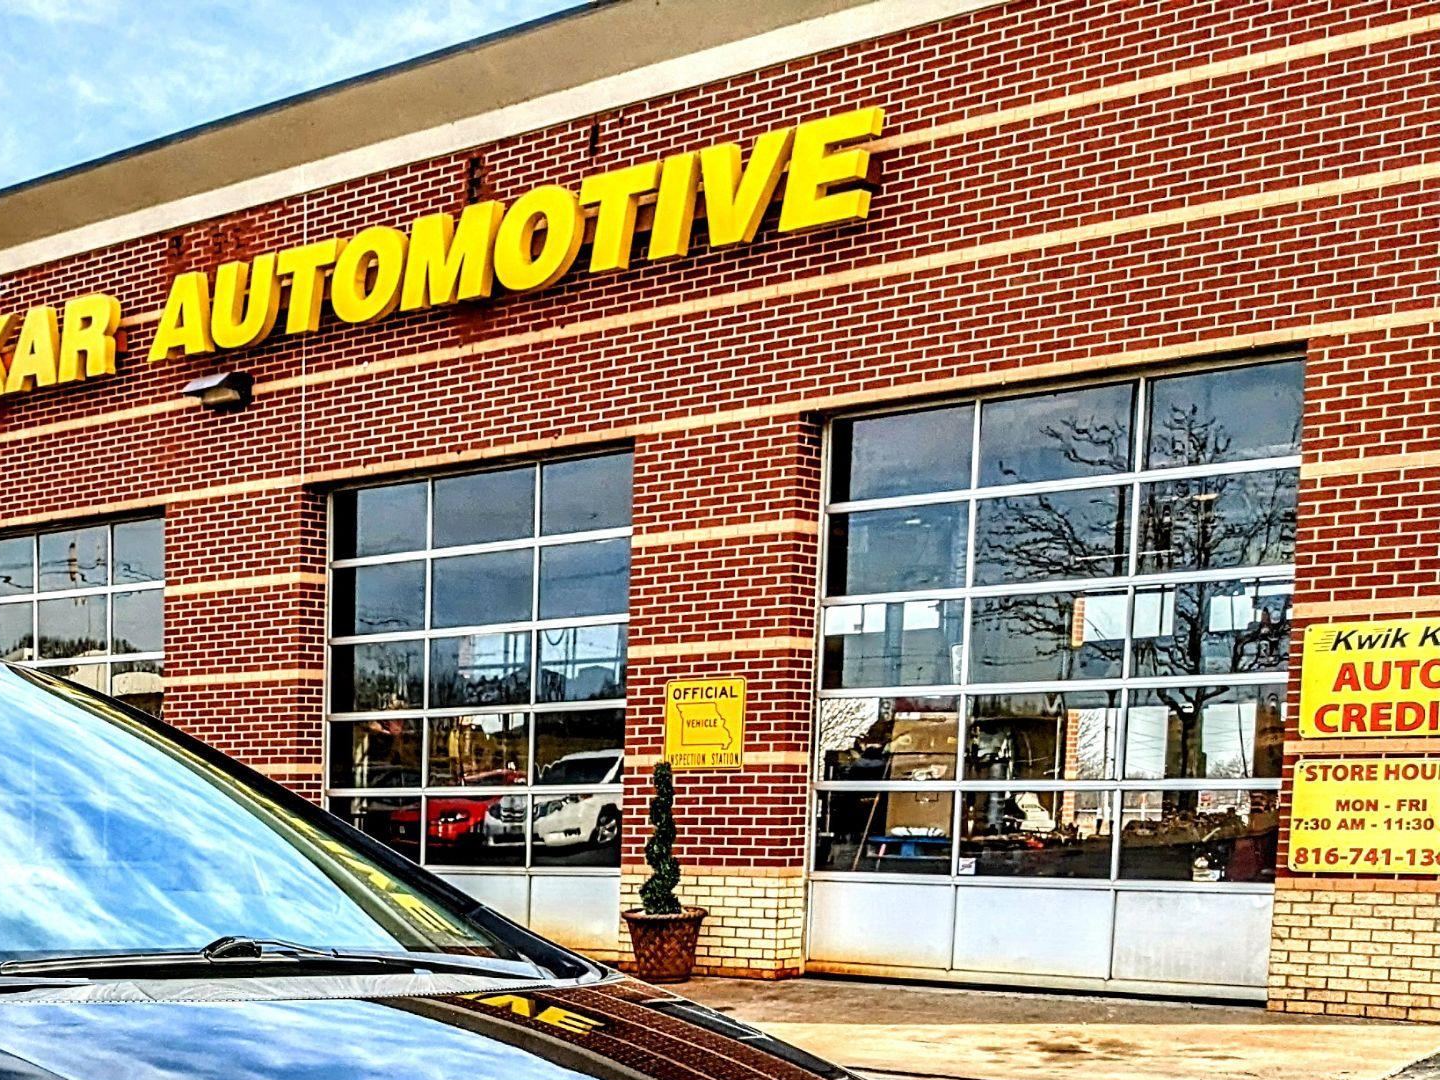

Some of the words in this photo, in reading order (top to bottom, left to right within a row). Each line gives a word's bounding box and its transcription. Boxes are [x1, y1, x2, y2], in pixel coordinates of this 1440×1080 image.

[147, 106, 885, 363] AUTOMOTIVE
[1331, 628, 1410, 651] Kwik
[1332, 658, 1440, 692] AUTO
[673, 686, 738, 700] OFFICIAL
[686, 718, 718, 728] VEHICLE
[1314, 701, 1440, 733] CREDI
[668, 753, 706, 766] INSPECTION
[711, 752, 739, 765] STATION
[1305, 764, 1378, 782] STORE
[1384, 763, 1440, 780] HOU
[1335, 799, 1379, 812] MON
[1396, 798, 1428, 811] FRI
[1293, 818, 1332, 831] 7:30
[1336, 818, 1366, 831] AM
[1383, 818, 1435, 831] 11:30
